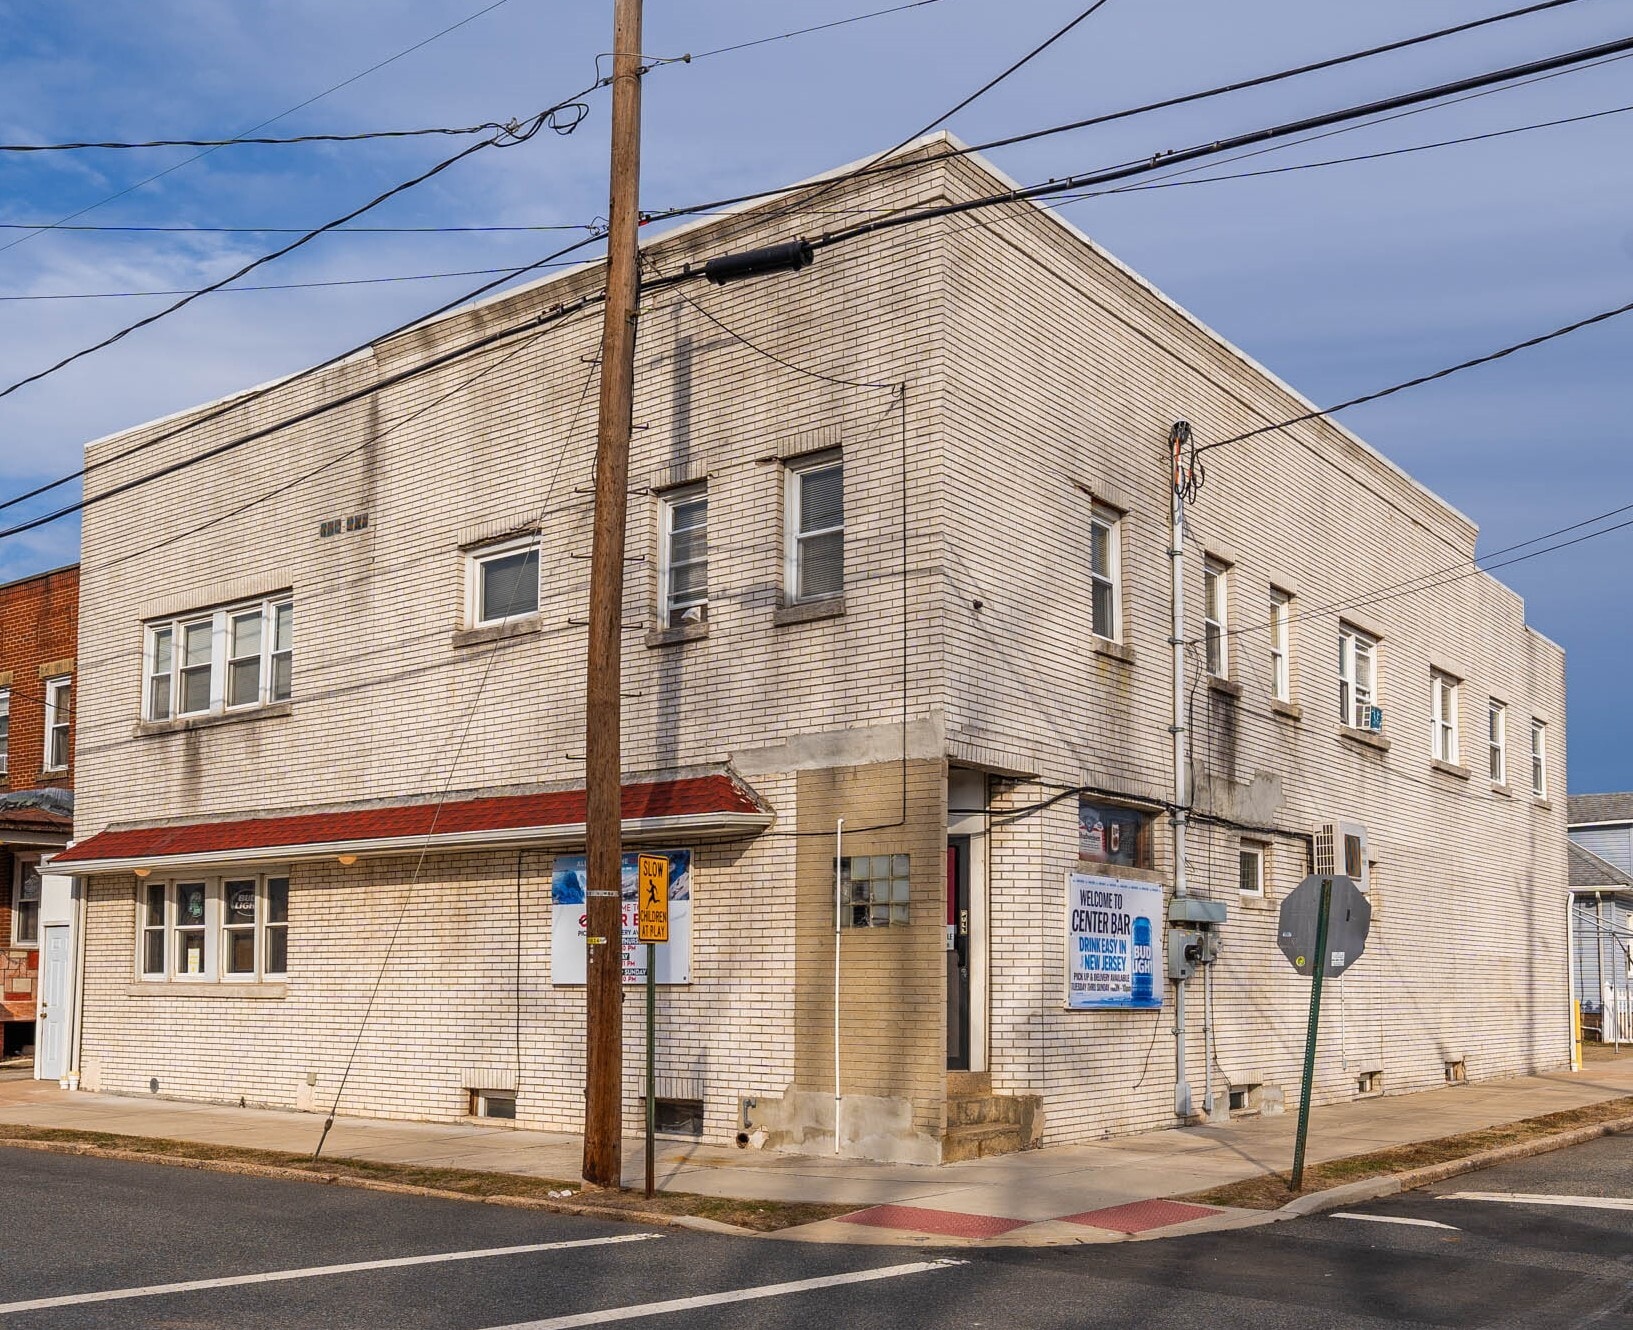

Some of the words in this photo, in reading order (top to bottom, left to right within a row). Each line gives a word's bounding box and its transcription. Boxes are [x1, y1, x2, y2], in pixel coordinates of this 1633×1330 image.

[643, 861, 664, 878] SLOW
[1079, 889, 1113, 909] WELCOME
[1114, 893, 1123, 910] TO
[640, 910, 667, 923] CHILDREN
[1072, 909, 1109, 934] CENTER
[1111, 912, 1131, 935] BAR
[641, 925, 649, 938] AT
[649, 925, 665, 938] PLAY
[1078, 936, 1101, 953] DRINK
[1101, 937, 1118, 954] EASY
[1119, 939, 1127, 955] IN
[1134, 945, 1152, 960] BUD
[1084, 954, 1100, 971] NEW
[1101, 955, 1127, 972] JERSEY
